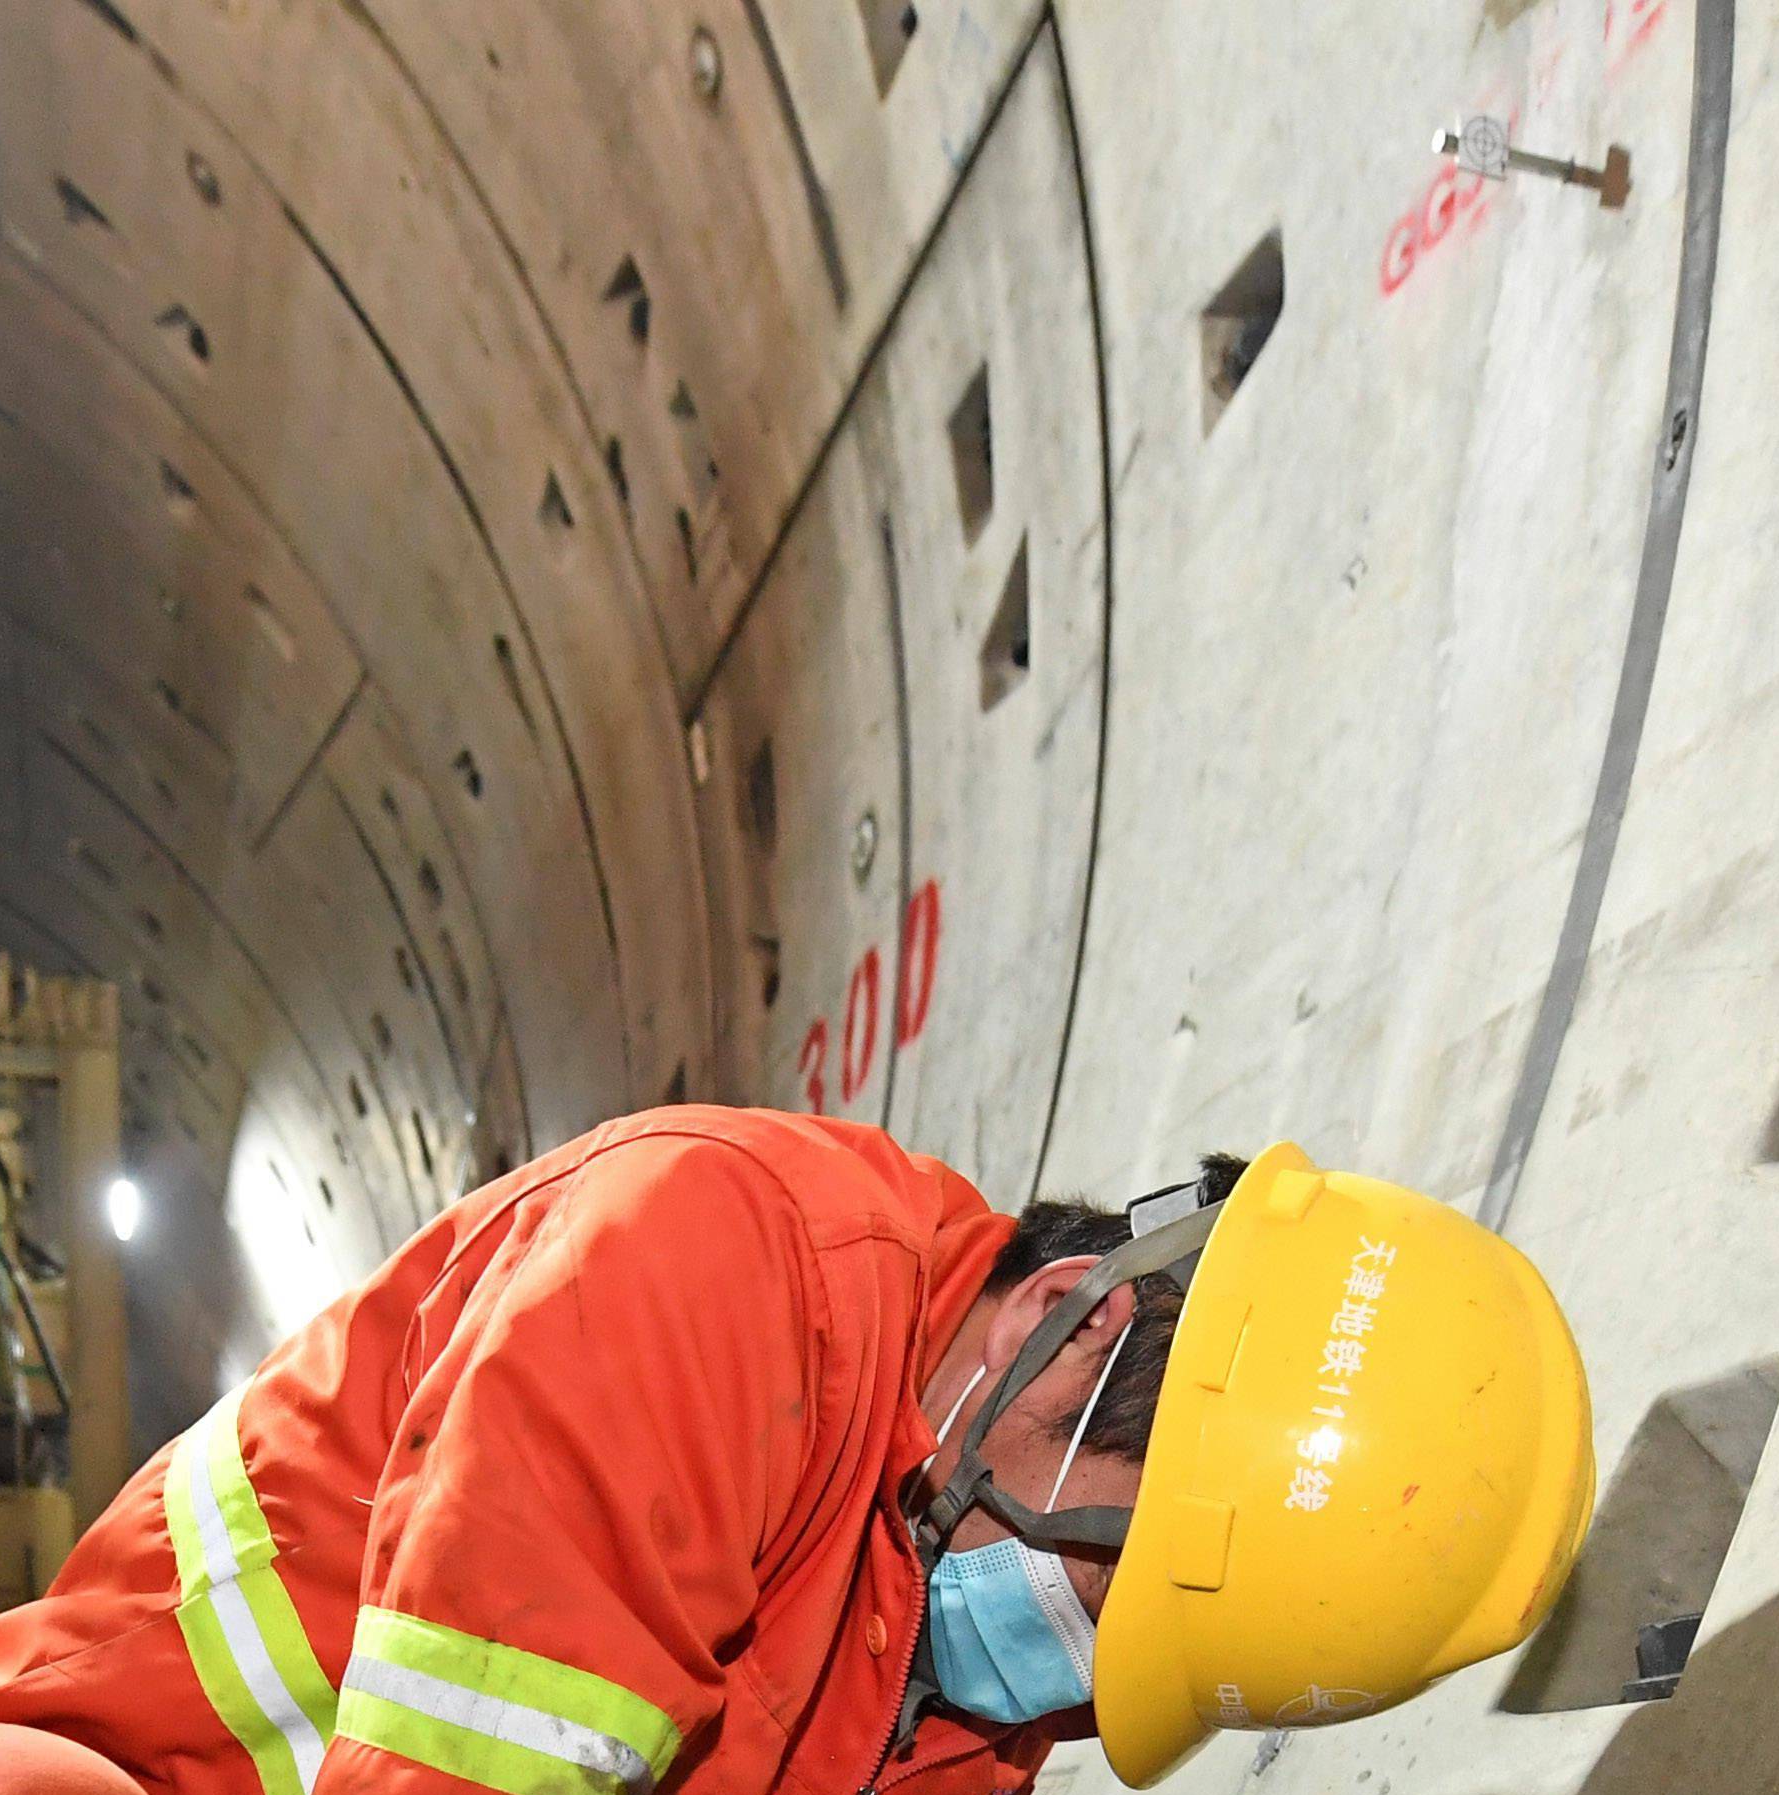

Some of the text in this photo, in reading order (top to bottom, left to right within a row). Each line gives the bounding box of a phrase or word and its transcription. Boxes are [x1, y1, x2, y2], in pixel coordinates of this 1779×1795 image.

[1284, 1234, 1397, 1512] 天津地铁11号线
